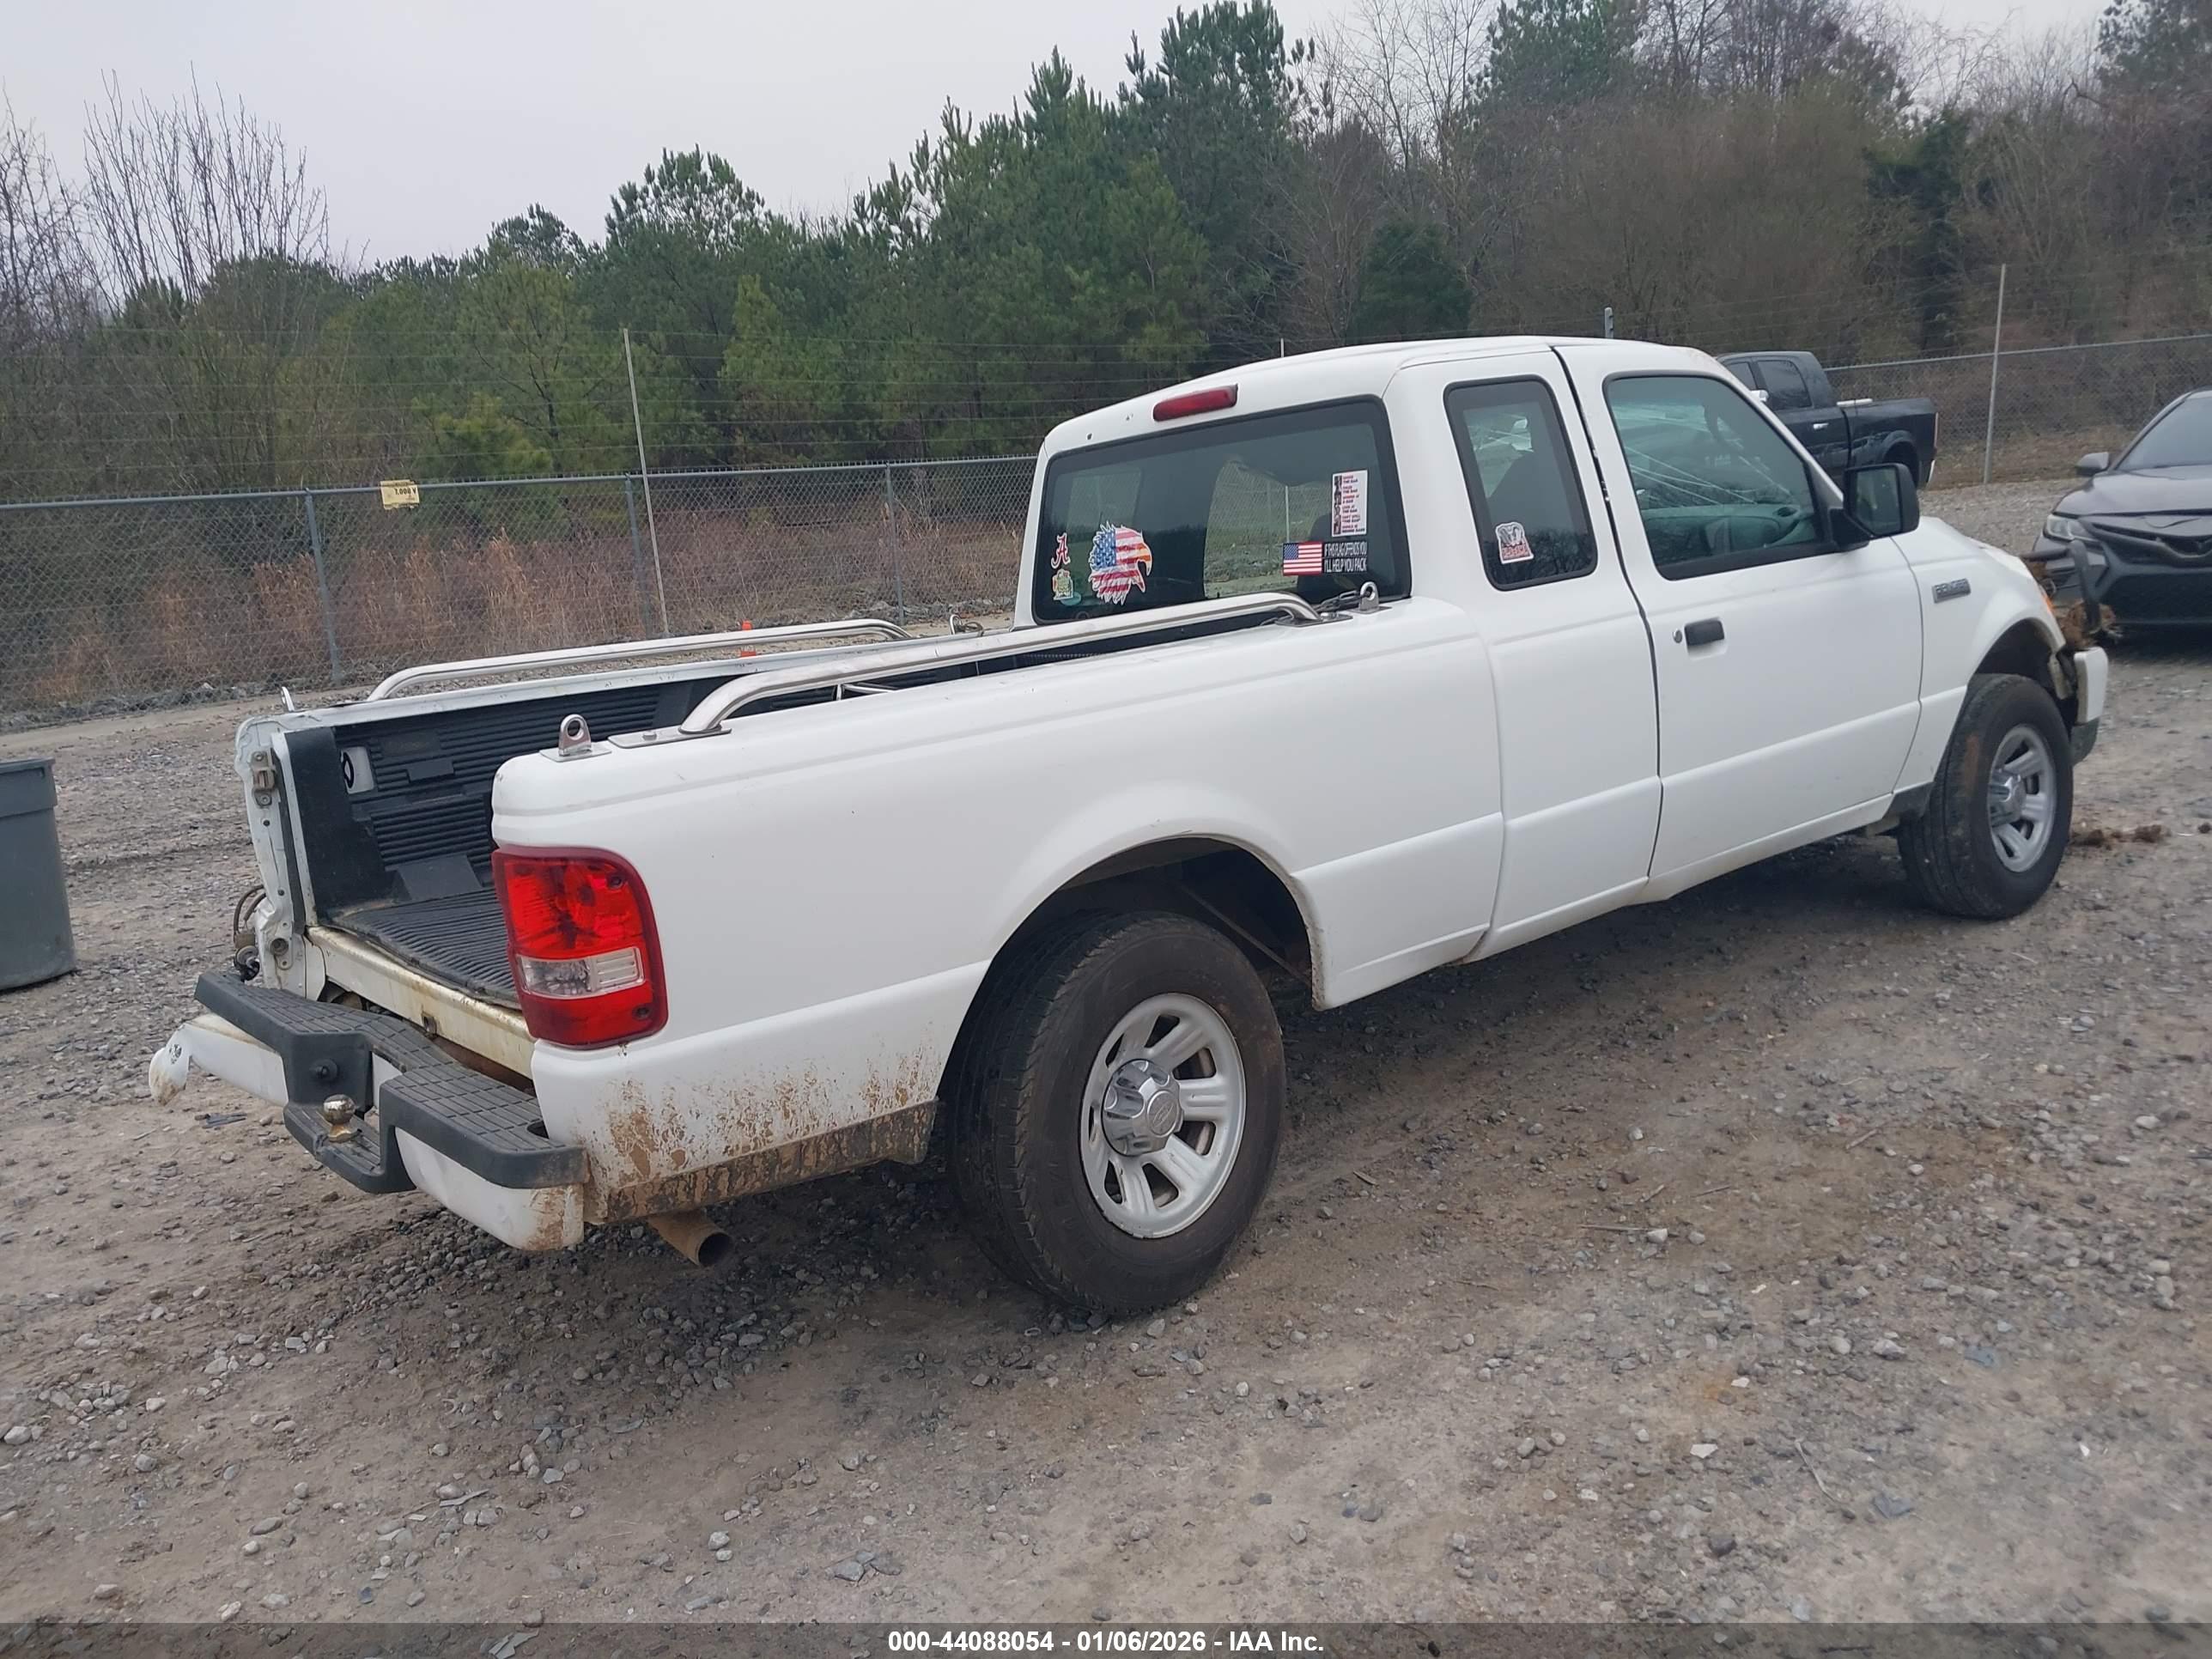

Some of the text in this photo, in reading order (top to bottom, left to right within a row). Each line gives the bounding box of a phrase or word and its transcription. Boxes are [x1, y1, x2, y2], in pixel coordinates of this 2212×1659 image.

[1359, 541, 1368, 555] YOU
[1333, 558, 1344, 572] HELP
[1345, 558, 1354, 572] YOU
[1354, 557, 1367, 572] PACK
